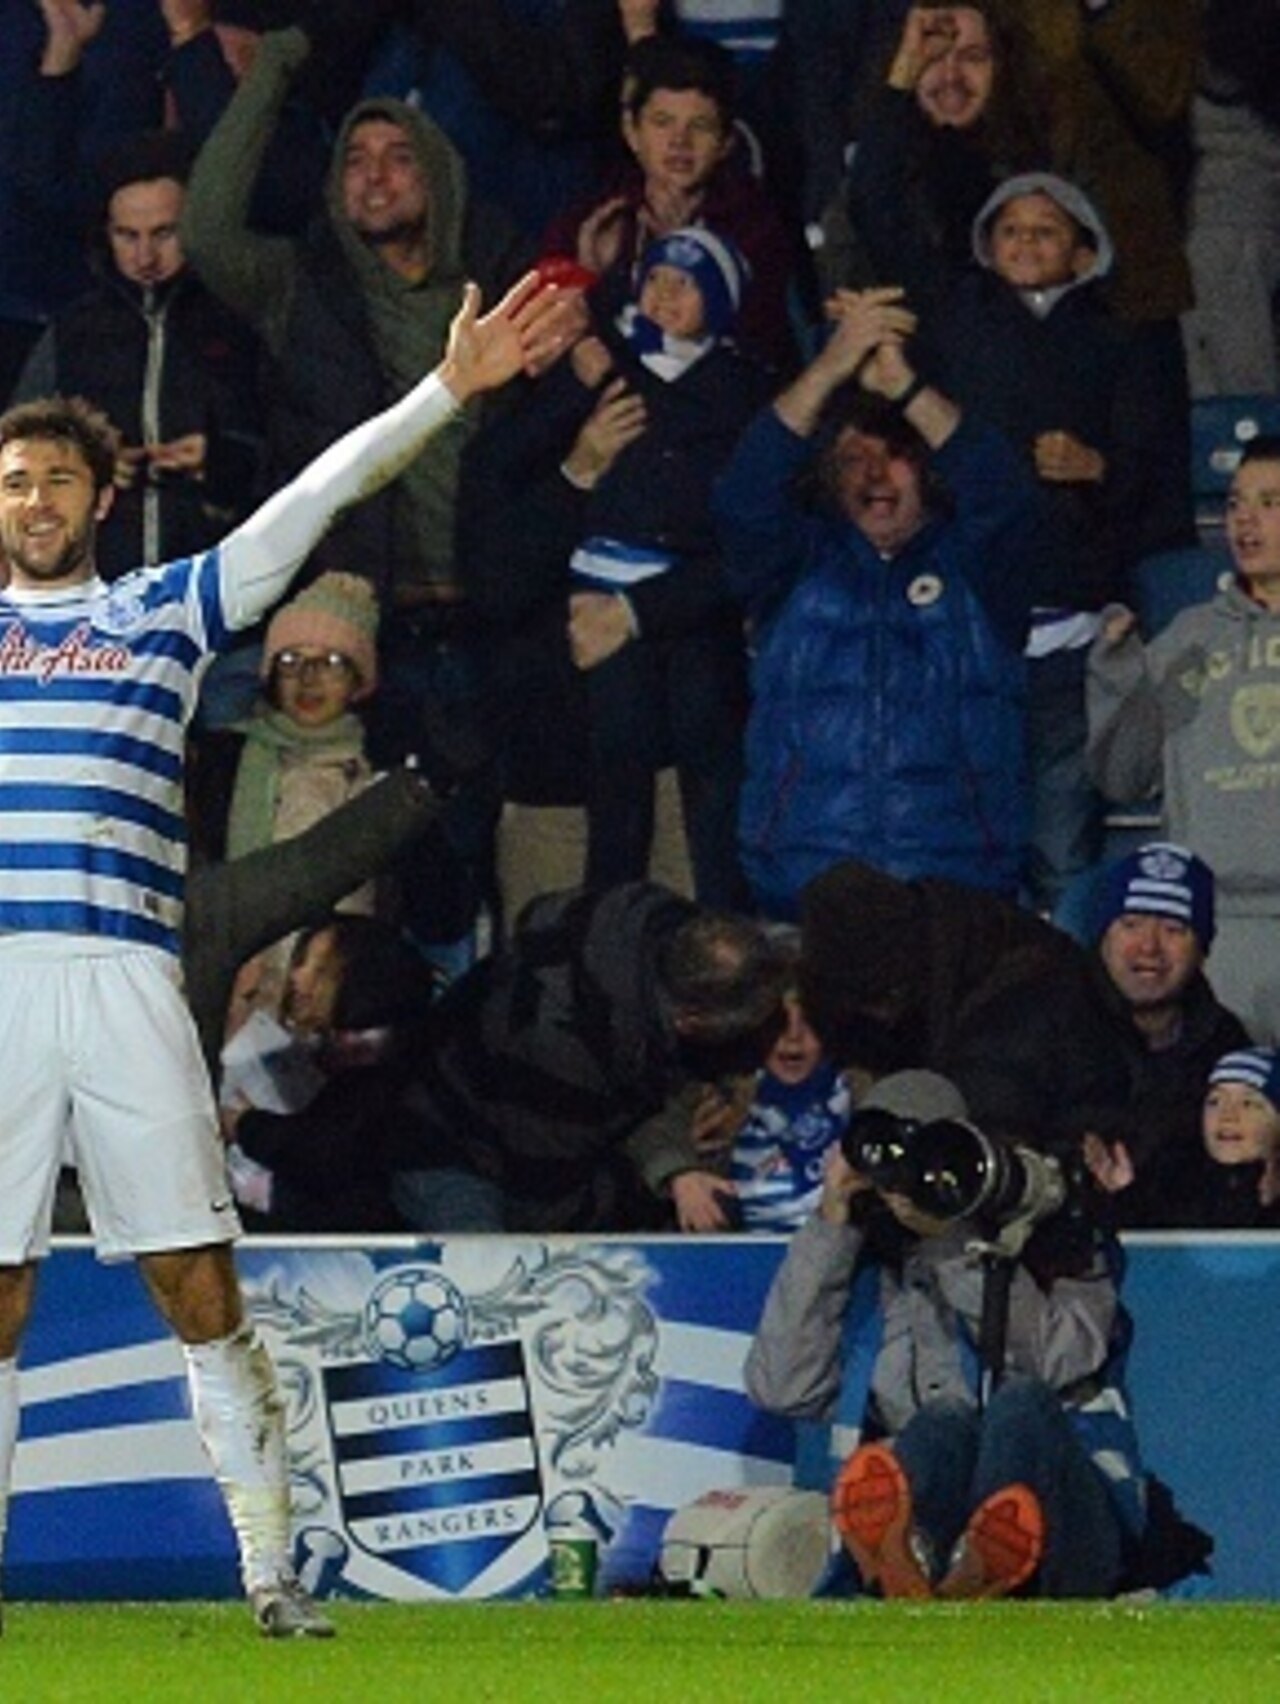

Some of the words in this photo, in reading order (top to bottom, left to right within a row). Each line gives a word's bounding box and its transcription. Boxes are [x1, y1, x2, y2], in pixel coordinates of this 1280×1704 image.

[369, 1388, 489, 1427] QUEENS
[399, 1456, 475, 1479] PARK
[375, 1504, 518, 1544] RANGERS
